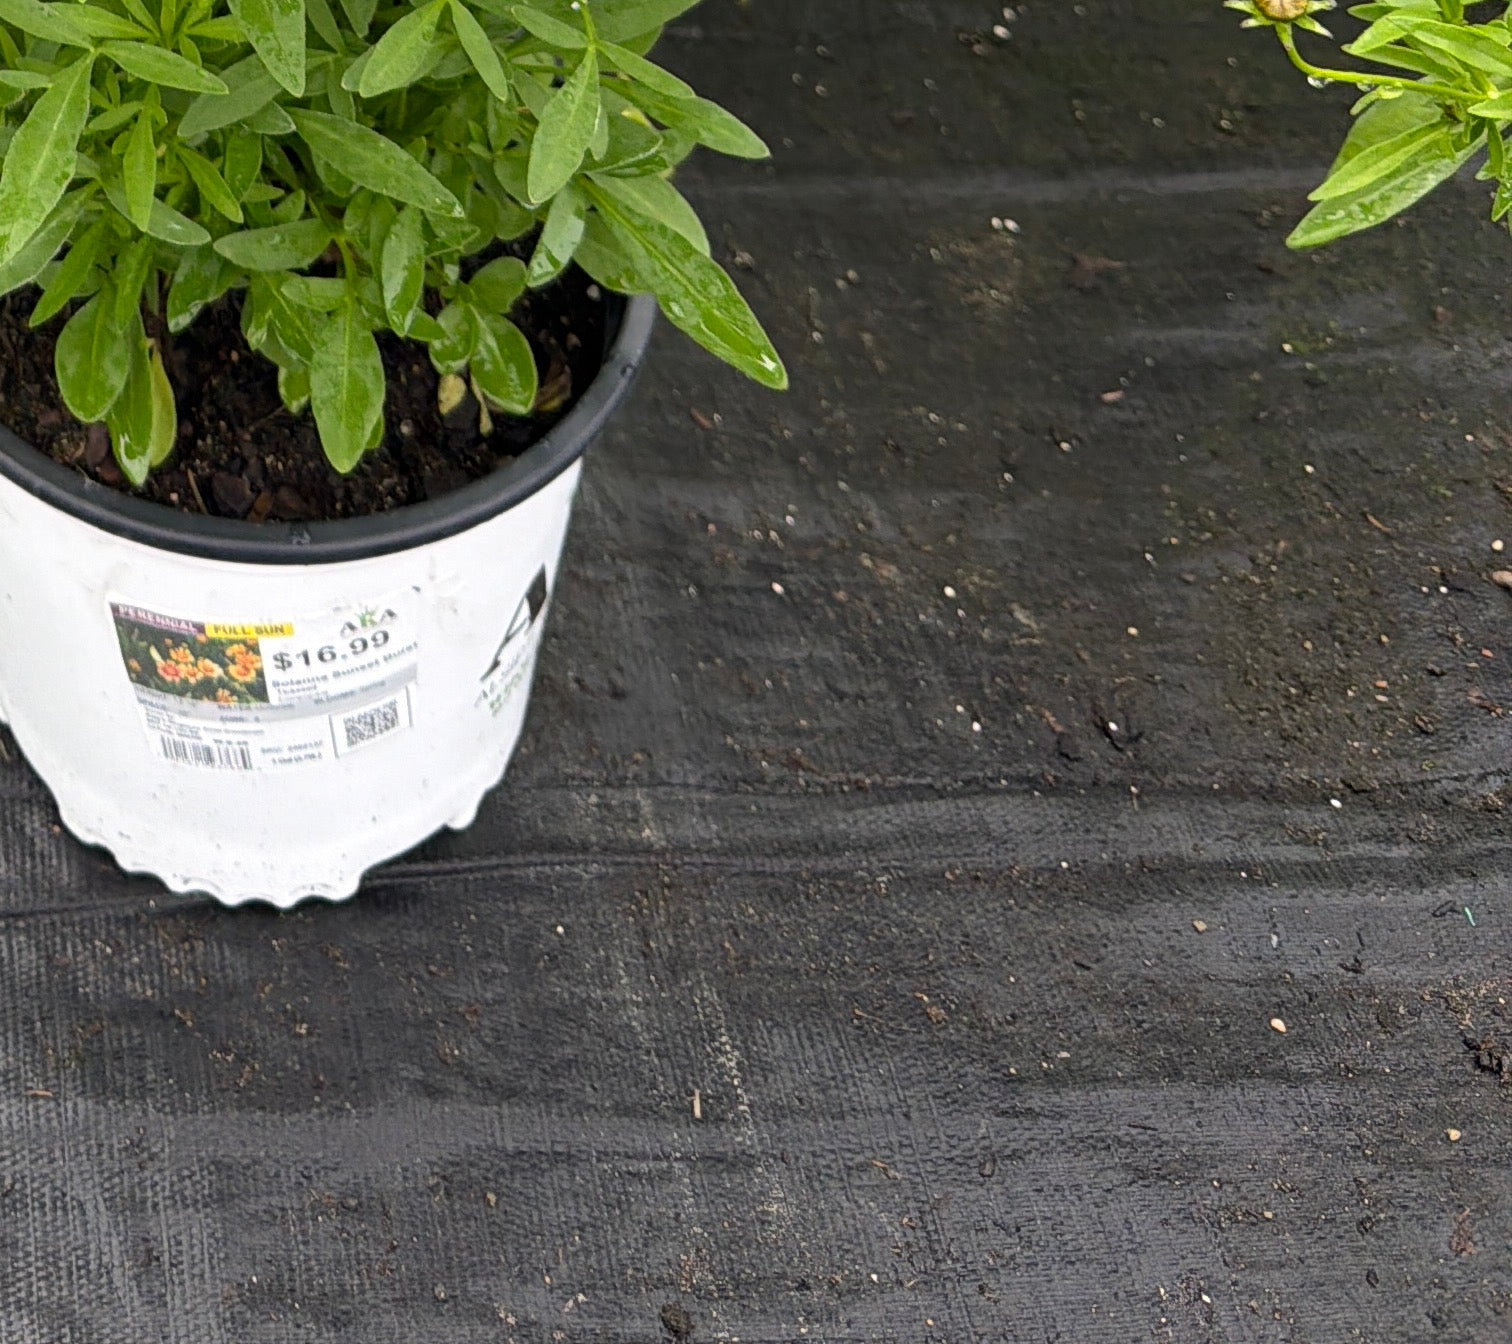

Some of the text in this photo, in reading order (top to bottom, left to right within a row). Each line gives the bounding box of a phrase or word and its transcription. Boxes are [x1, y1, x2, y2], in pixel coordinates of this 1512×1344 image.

[213, 622, 286, 635] FULL SUN
[272, 629, 390, 672] $16.99
